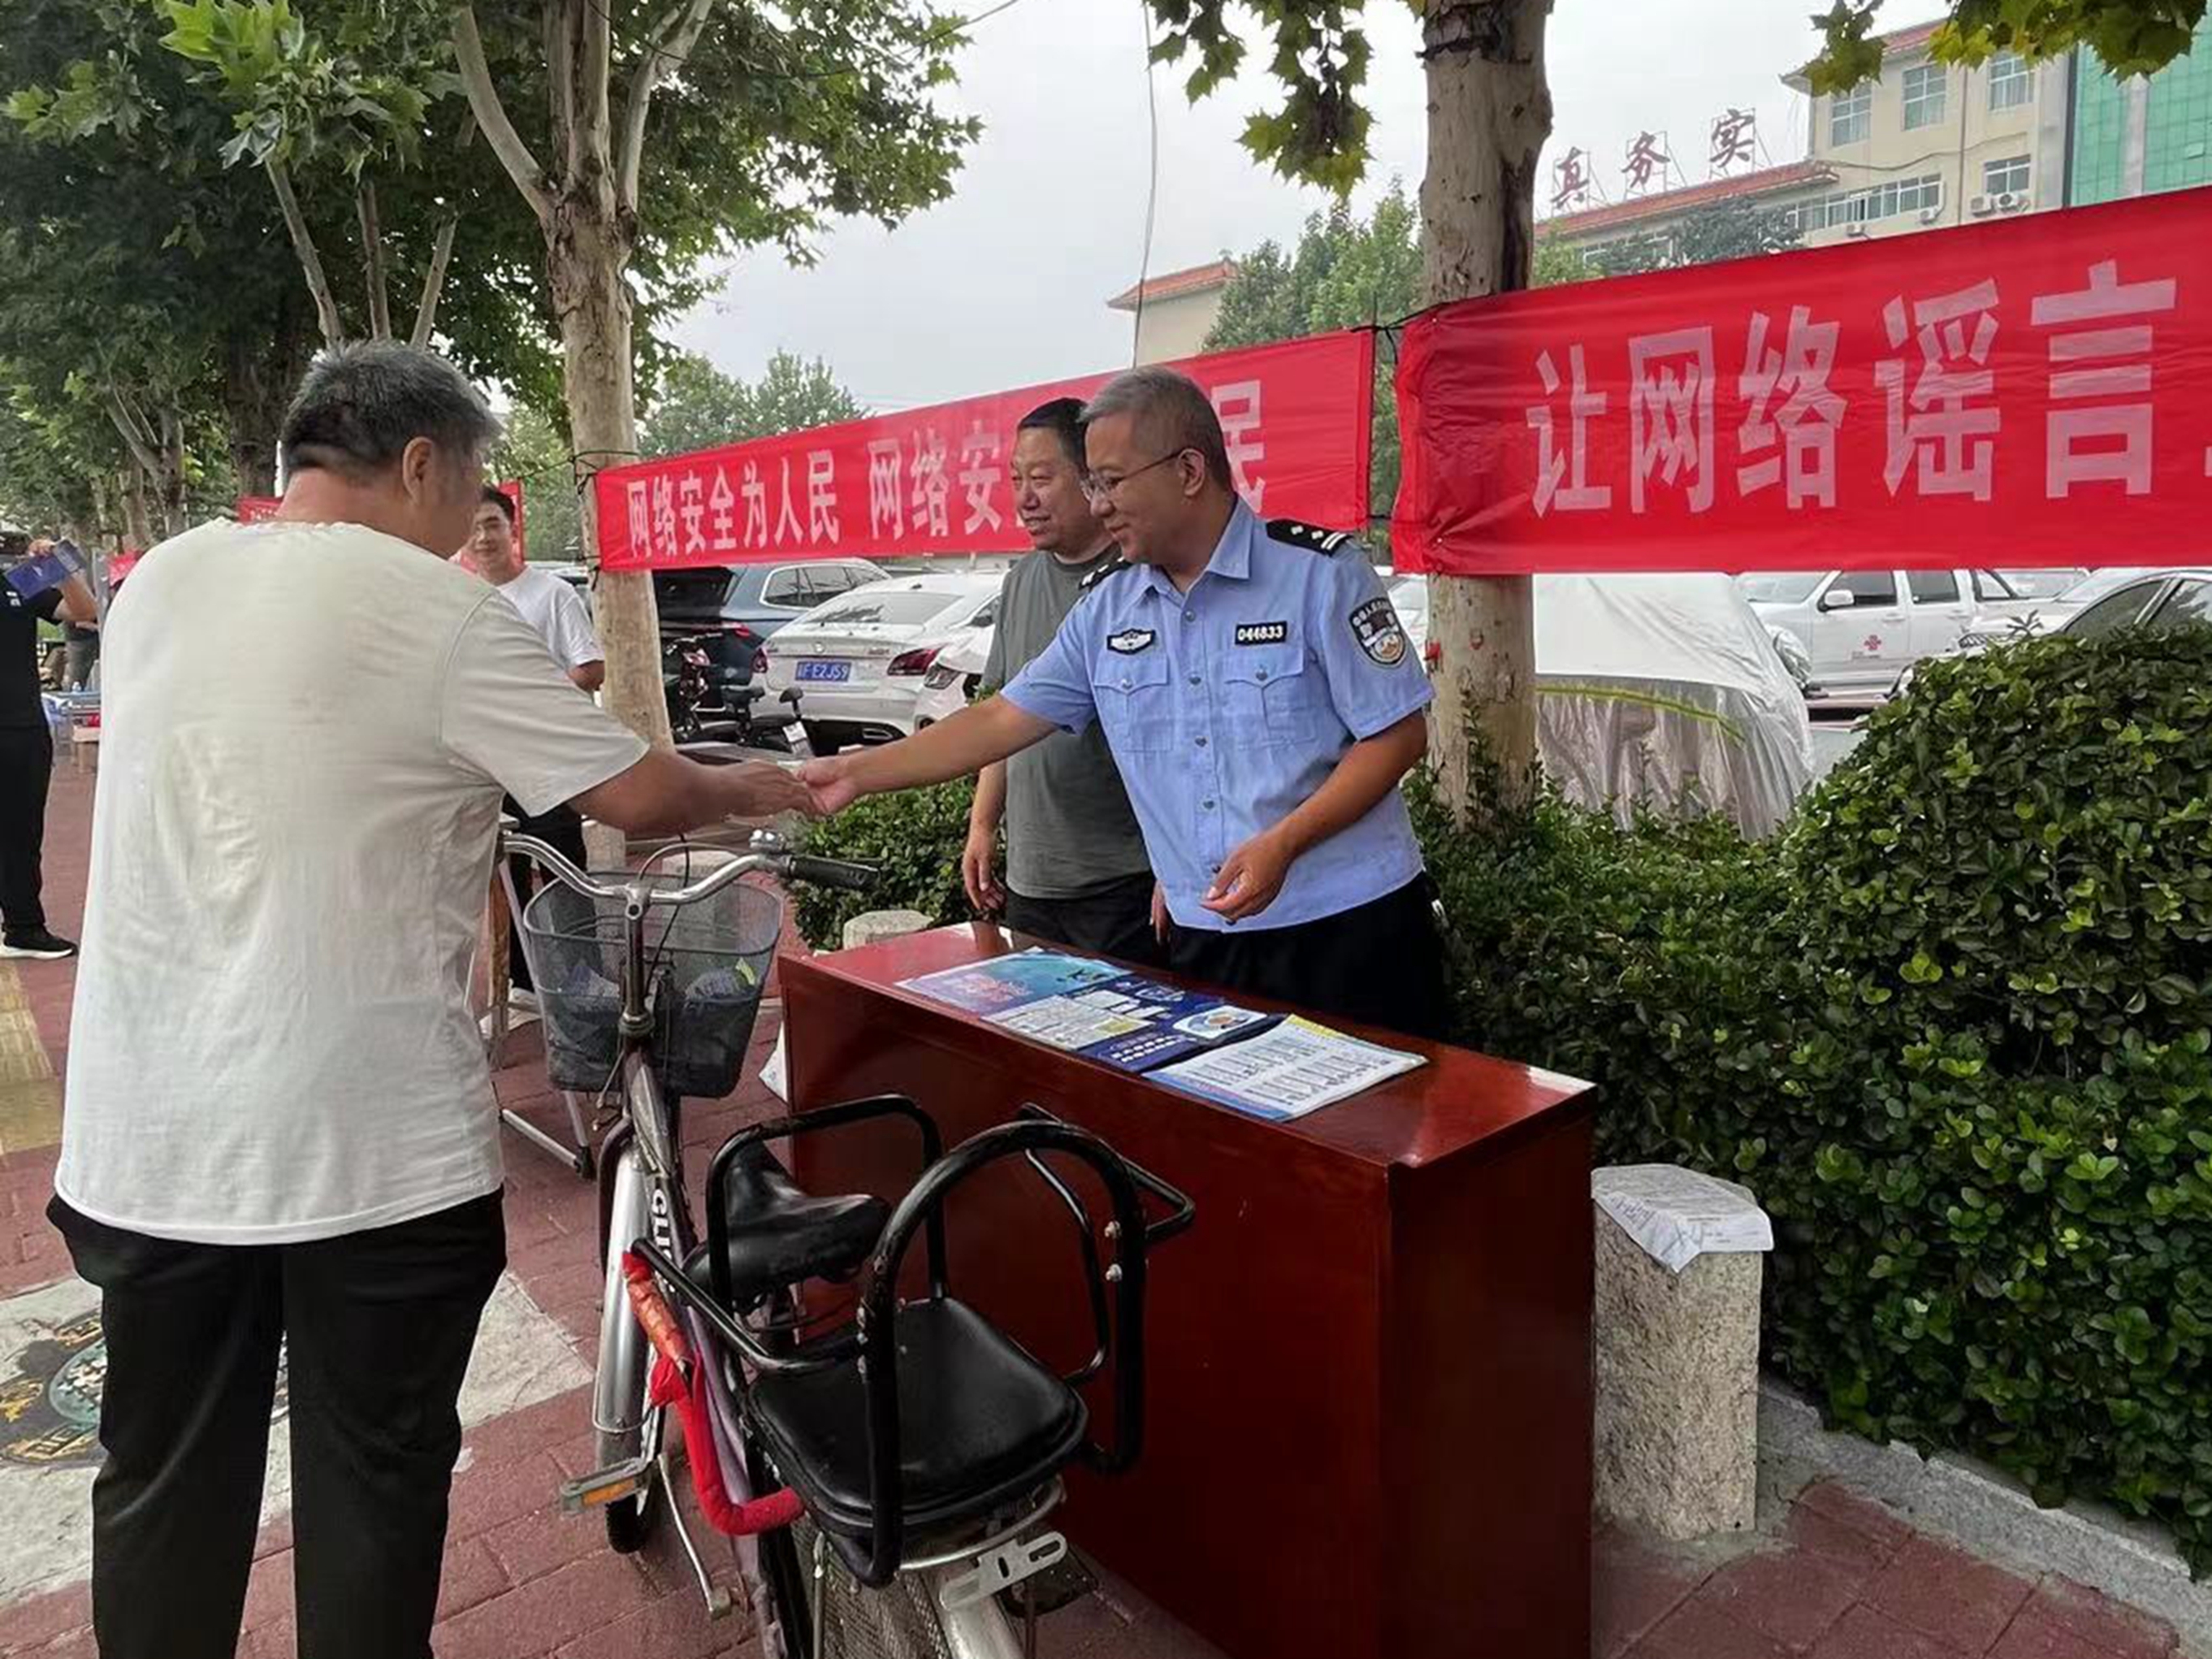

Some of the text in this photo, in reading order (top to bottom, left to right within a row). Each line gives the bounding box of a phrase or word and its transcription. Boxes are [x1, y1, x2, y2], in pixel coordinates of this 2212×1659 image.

[1527, 258, 2212, 518] 让网络谣言
[627, 449, 840, 558] 网络安全为人民
